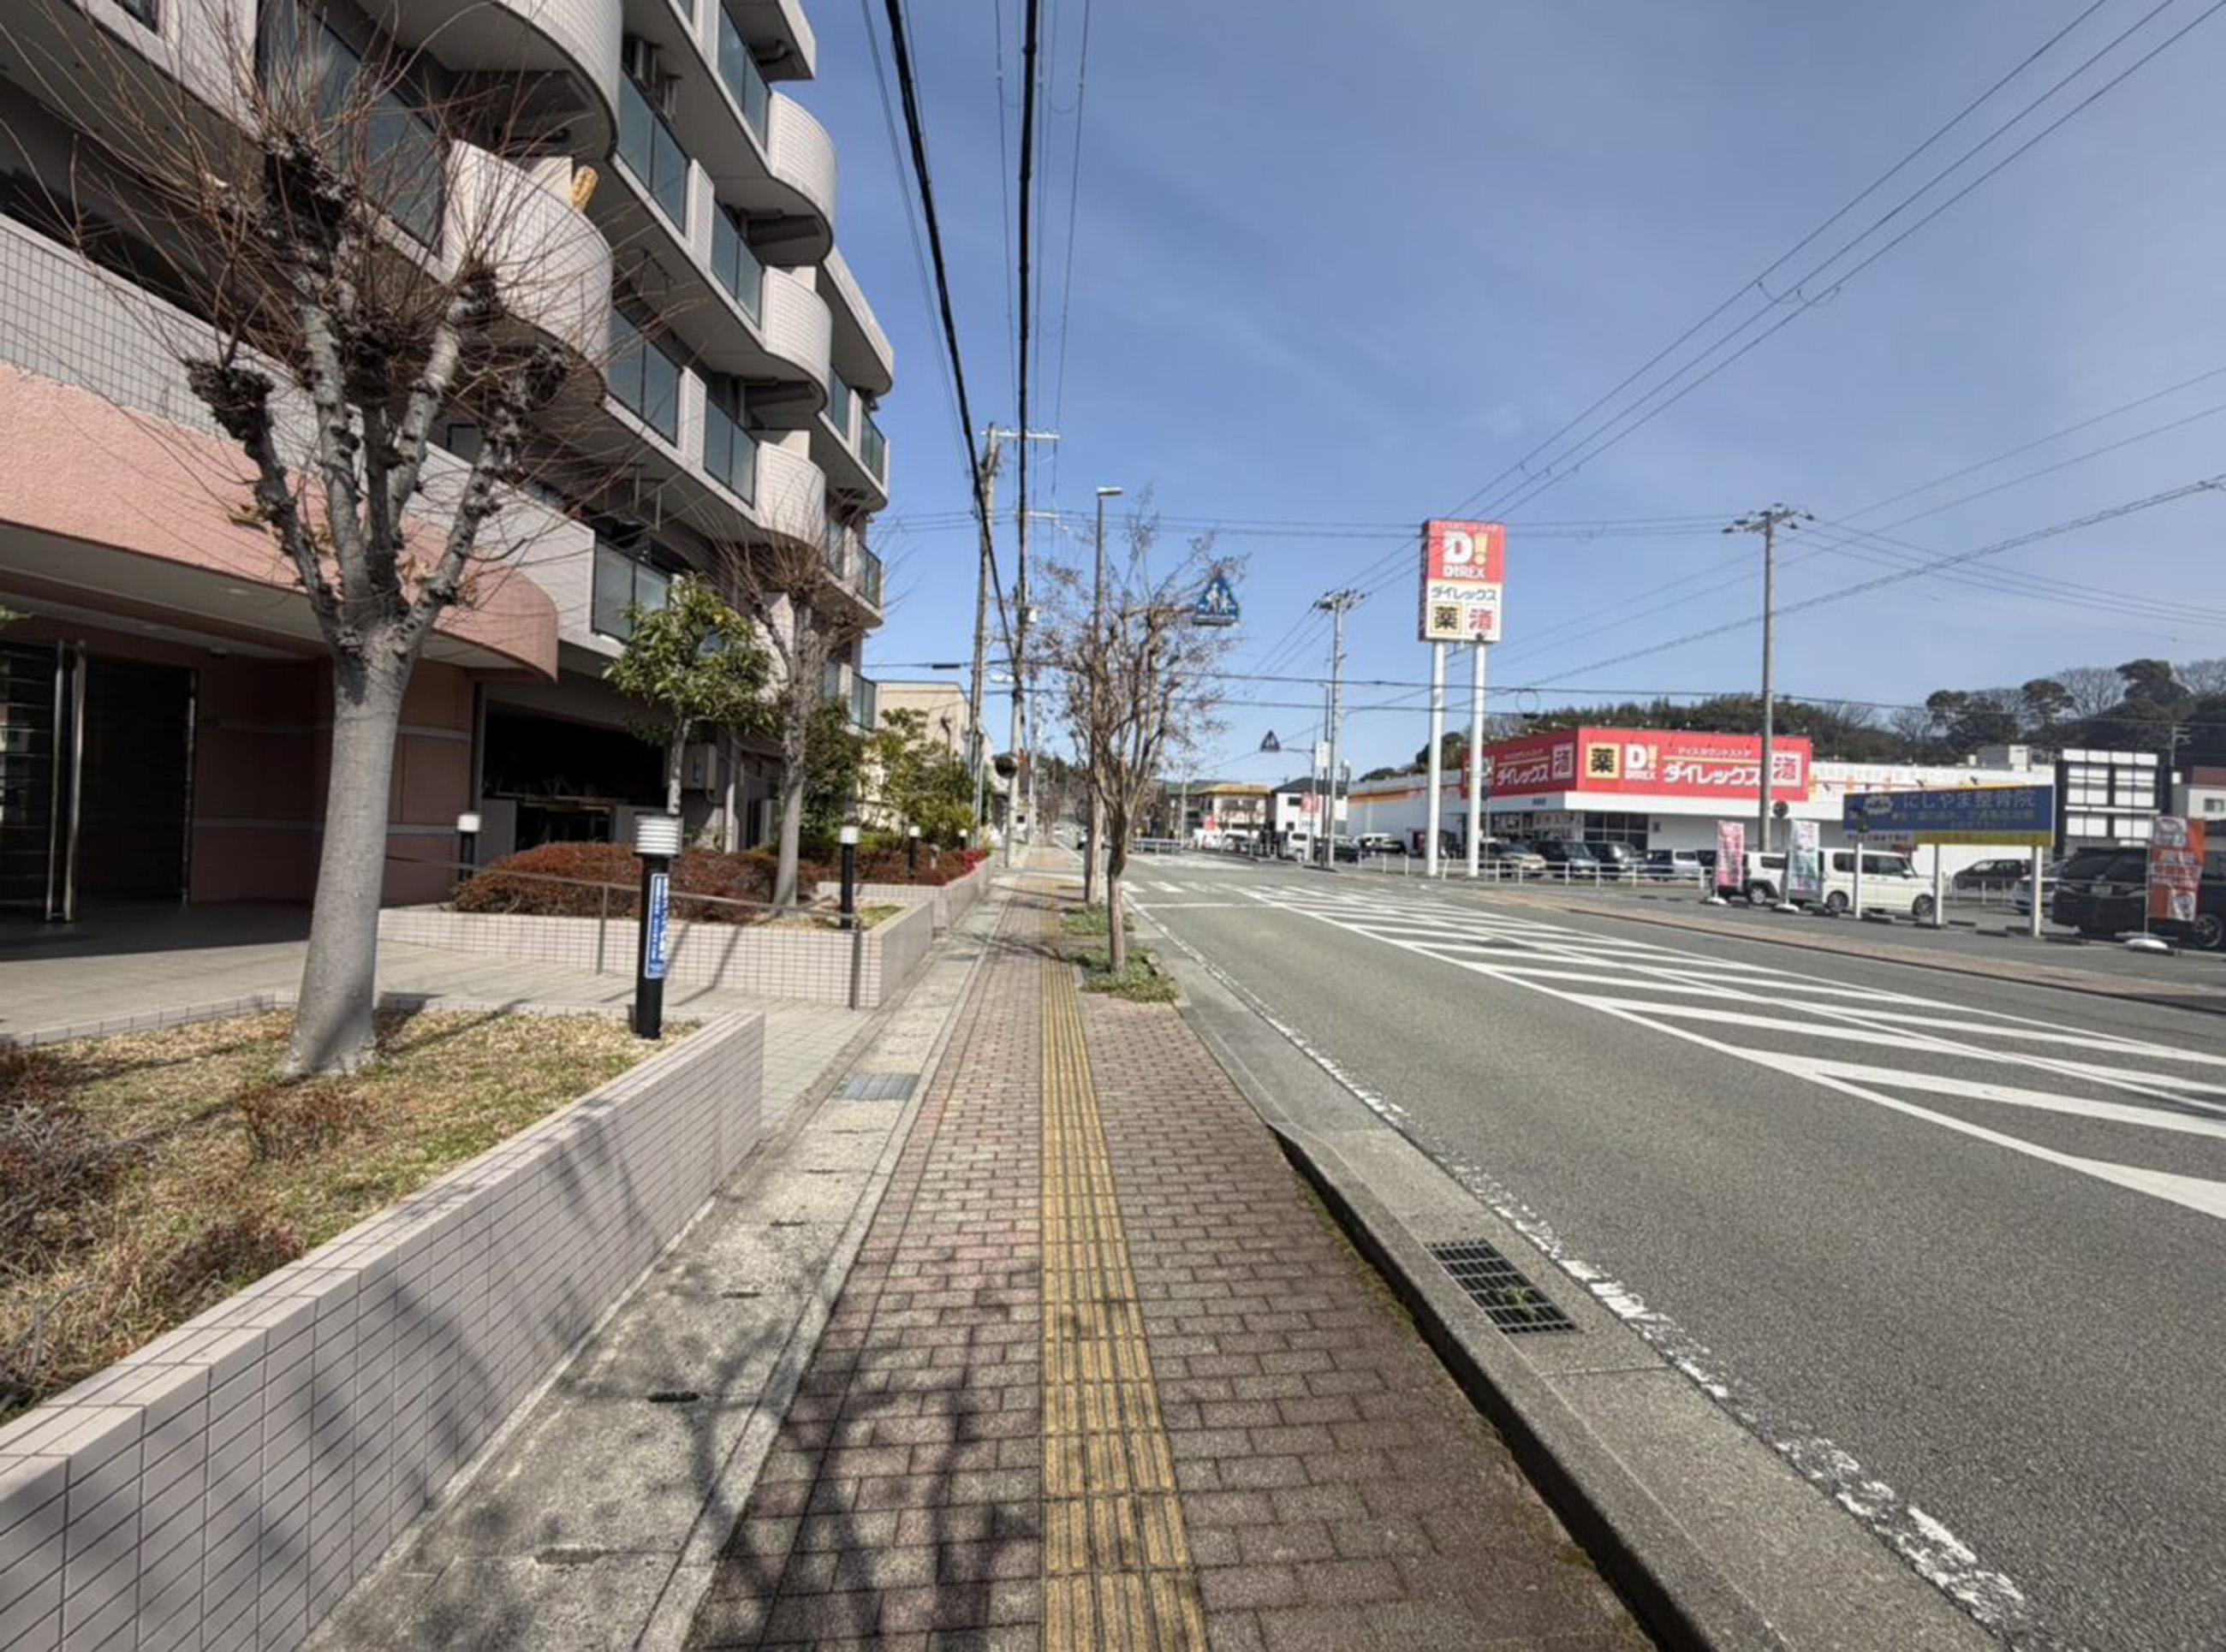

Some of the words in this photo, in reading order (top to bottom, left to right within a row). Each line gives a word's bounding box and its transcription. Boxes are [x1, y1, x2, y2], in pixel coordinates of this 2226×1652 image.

[1431, 586, 1497, 601] ダイレックス
[1434, 606, 1458, 629] 薬
[1591, 747, 1615, 773] 薬
[1663, 761, 1761, 786] ダイレックス
